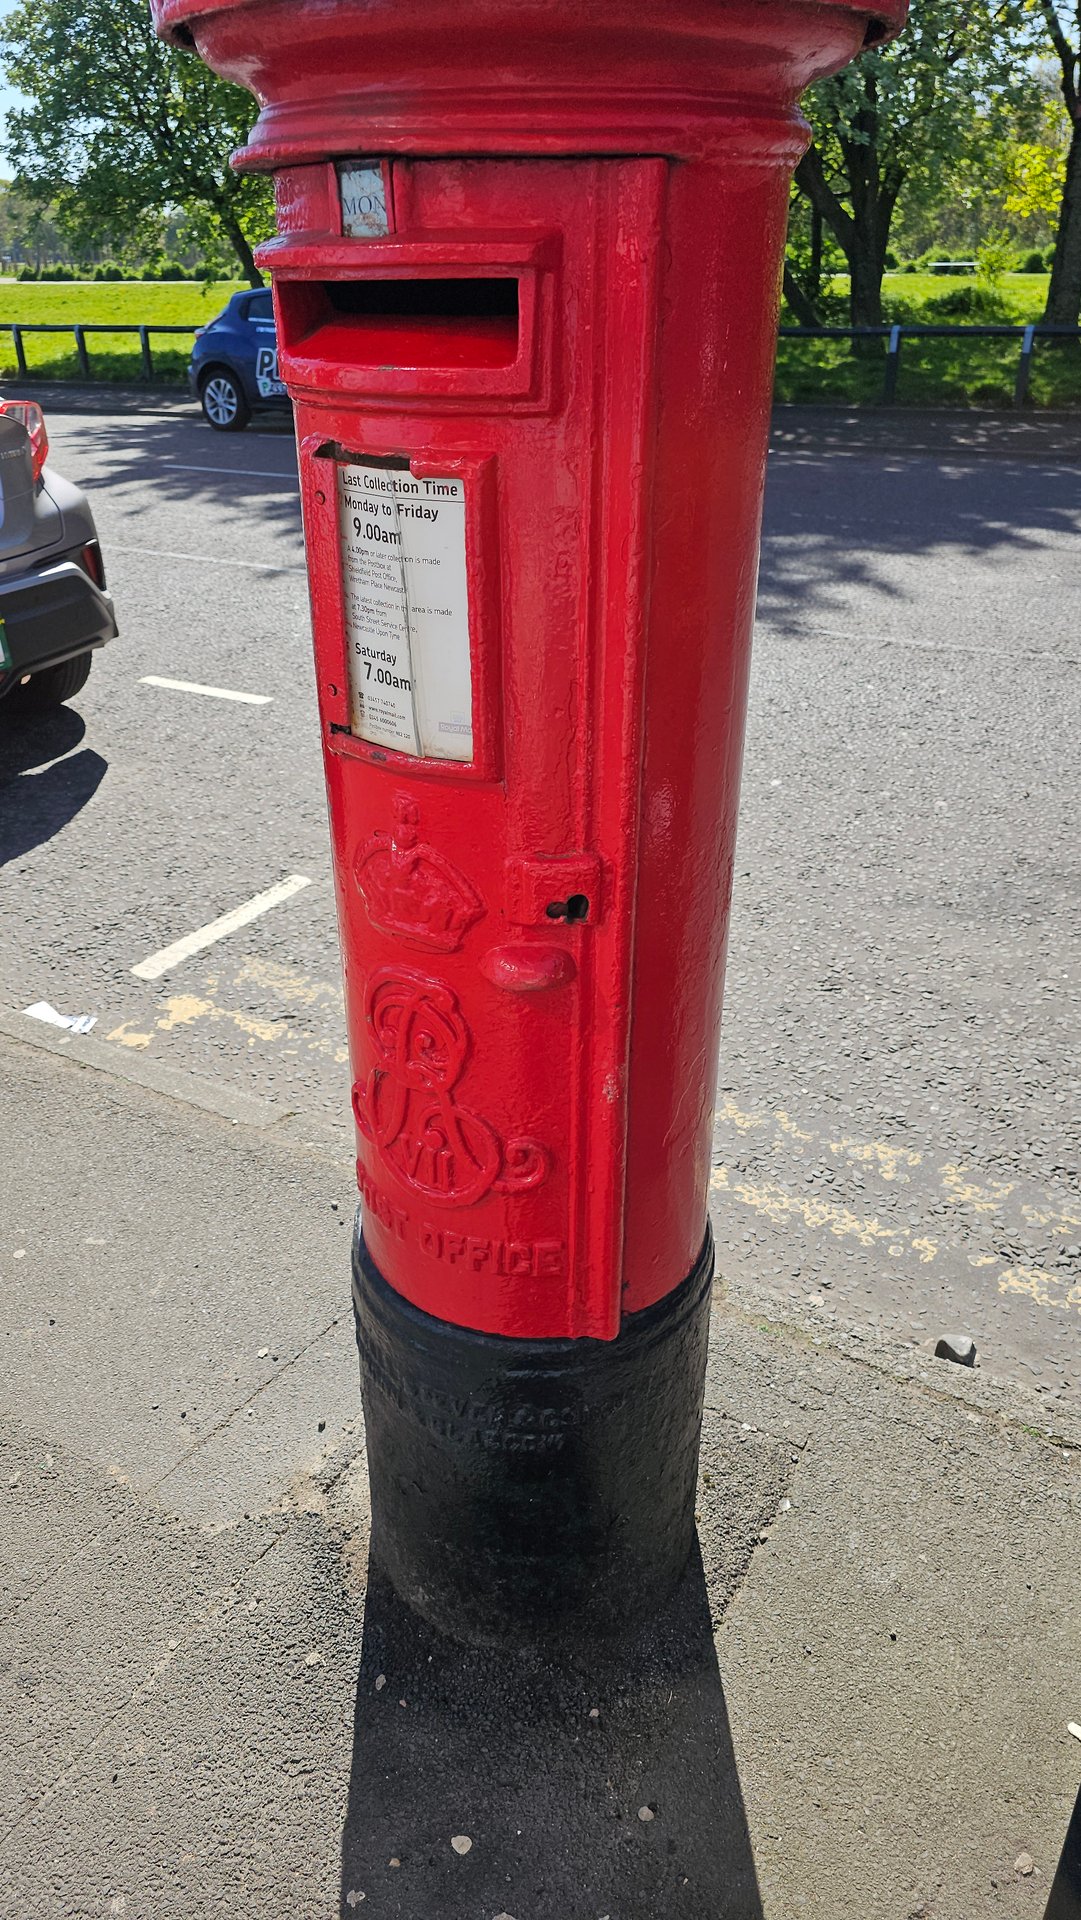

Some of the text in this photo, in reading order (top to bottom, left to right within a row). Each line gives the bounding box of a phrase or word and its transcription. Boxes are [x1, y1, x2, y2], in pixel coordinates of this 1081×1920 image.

[343, 192, 387, 215] MON
[342, 471, 458, 496] Last Collection Time
[344, 495, 439, 522] Monday to Friday
[353, 517, 402, 546] 9.00am
[415, 555, 421, 563] is
[422, 557, 441, 566] made
[411, 606, 426, 614] area
[427, 606, 433, 614] is
[434, 608, 453, 616] made
[355, 642, 397, 667] Saturday
[363, 661, 412, 692] 7.00am
[356, 1158, 567, 1277] OST OFFICE
